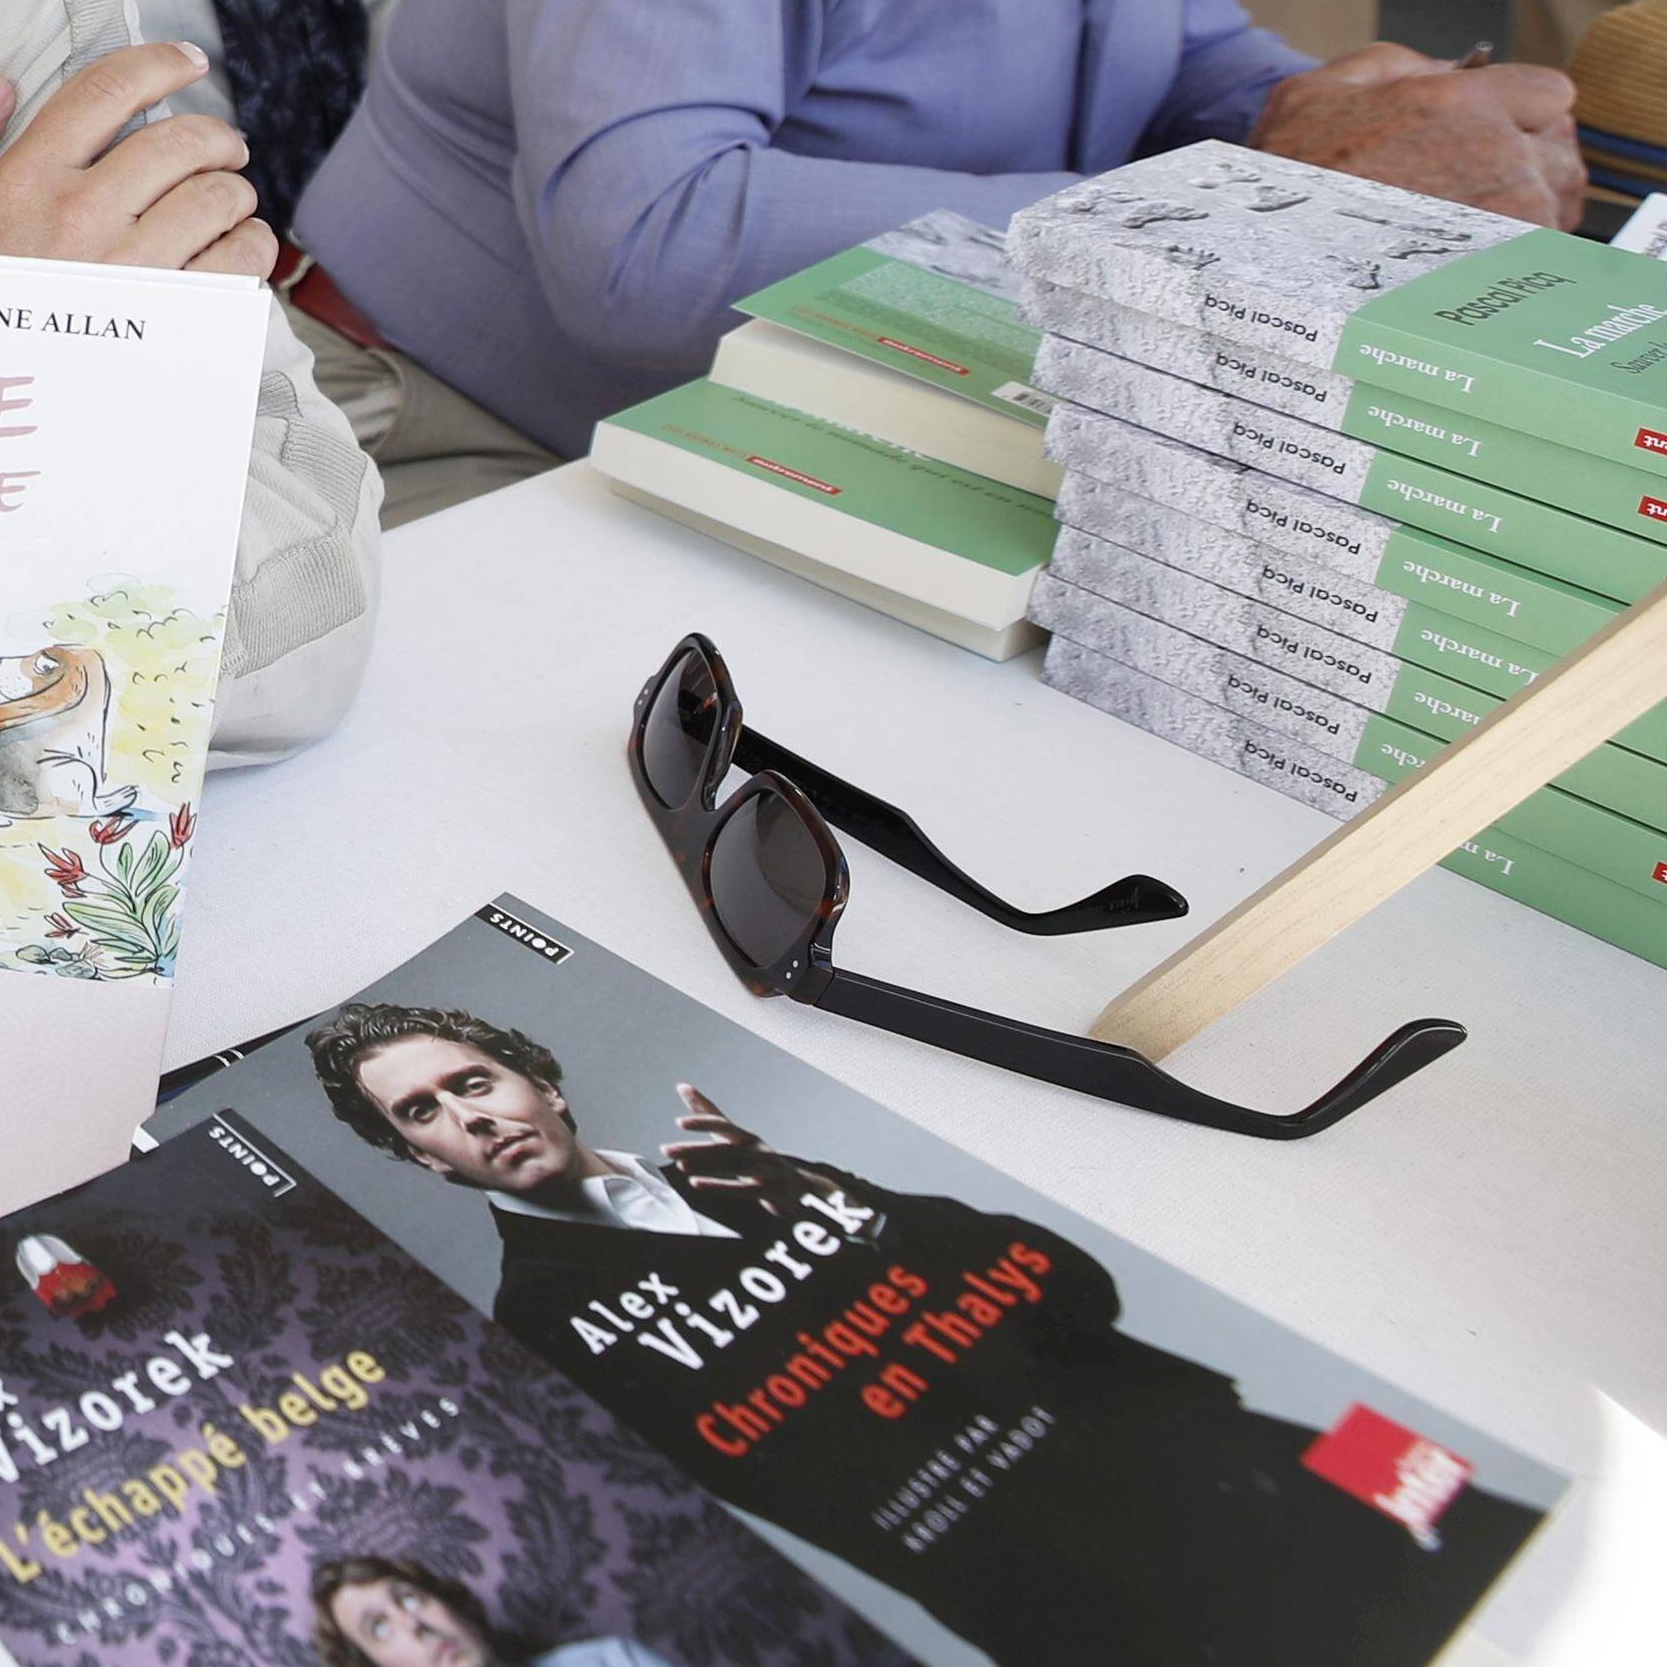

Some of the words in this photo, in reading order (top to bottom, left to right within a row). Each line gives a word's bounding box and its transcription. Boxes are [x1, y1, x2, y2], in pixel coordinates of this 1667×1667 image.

[1203, 294, 1246, 320] Picq
[1435, 286, 1510, 327] Pascal
[1505, 271, 1577, 304] Picq
[41, 312, 145, 340] ALLAN
[1250, 311, 1318, 342] Pascal
[1215, 352, 1257, 379] Picq
[1359, 344, 1440, 376] marche
[1261, 370, 1327, 403] Pascal
[1445, 370, 1475, 393] La
[1232, 422, 1275, 449] Picq
[1368, 406, 1446, 439] marche
[1278, 441, 1346, 475] Pascal
[1451, 433, 1482, 457] La
[1245, 499, 1288, 527] Picq
[1387, 479, 1467, 514] marche
[1472, 508, 1502, 533] La
[1292, 520, 1361, 555] Pascal
[1403, 561, 1484, 598] marche
[1489, 592, 1521, 617] La
[1421, 630, 1503, 668] marche
[490, 913, 559, 956] POINTS
[208, 1125, 280, 1186] POINTS
[637, 1190, 874, 1369] Vizorek
[570, 1272, 679, 1354] Alex
[862, 1362, 929, 1418] en
[903, 1242, 1051, 1362] Thalys
[697, 1266, 928, 1456] Chroniques
[240, 1351, 385, 1443] belge
